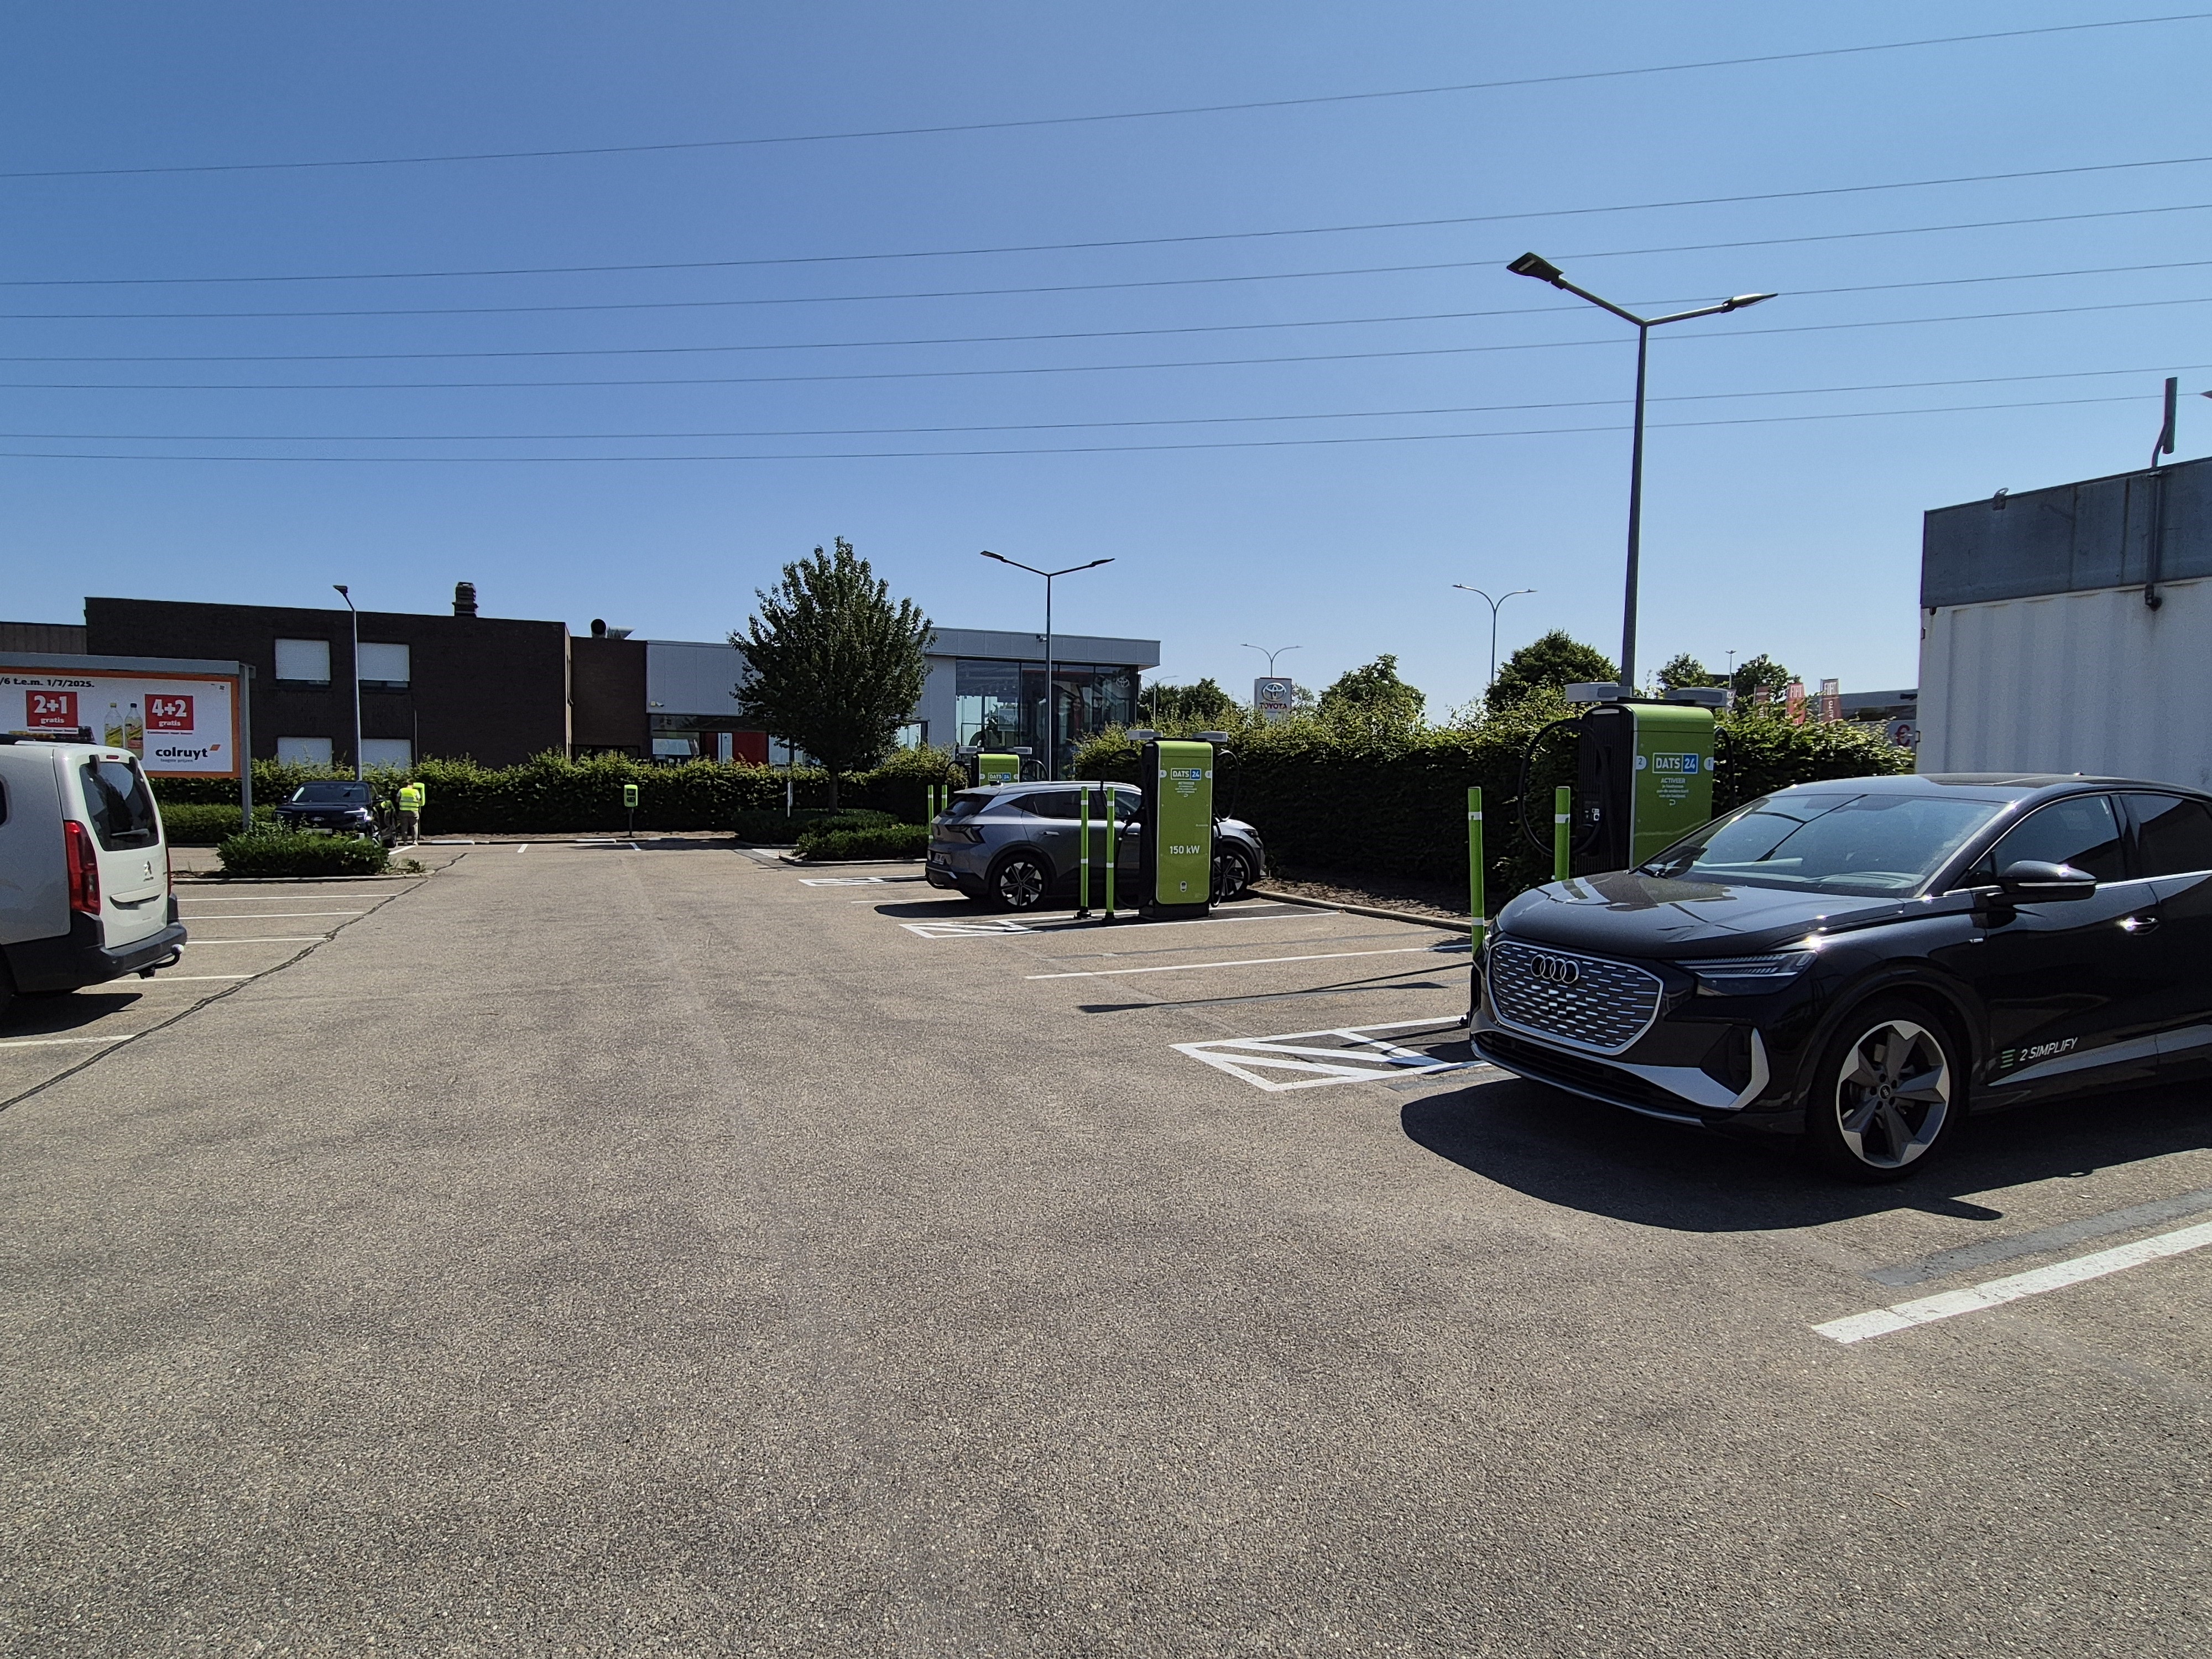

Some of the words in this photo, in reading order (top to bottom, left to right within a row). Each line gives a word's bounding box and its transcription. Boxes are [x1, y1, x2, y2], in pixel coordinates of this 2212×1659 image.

[47, 679, 95, 688] 1/7/2025.
[34, 695, 68, 714] 2+1
[152, 698, 187, 717] 4+2
[155, 747, 208, 760] colruyt
[1656, 757, 1681, 769] DATS
[1684, 758, 1696, 769] 24
[1170, 845, 1185, 854] 150
[1186, 845, 1200, 854] kW
[2019, 1048, 2028, 1061] 2
[2028, 1037, 2079, 1059] SIMPLIFY
